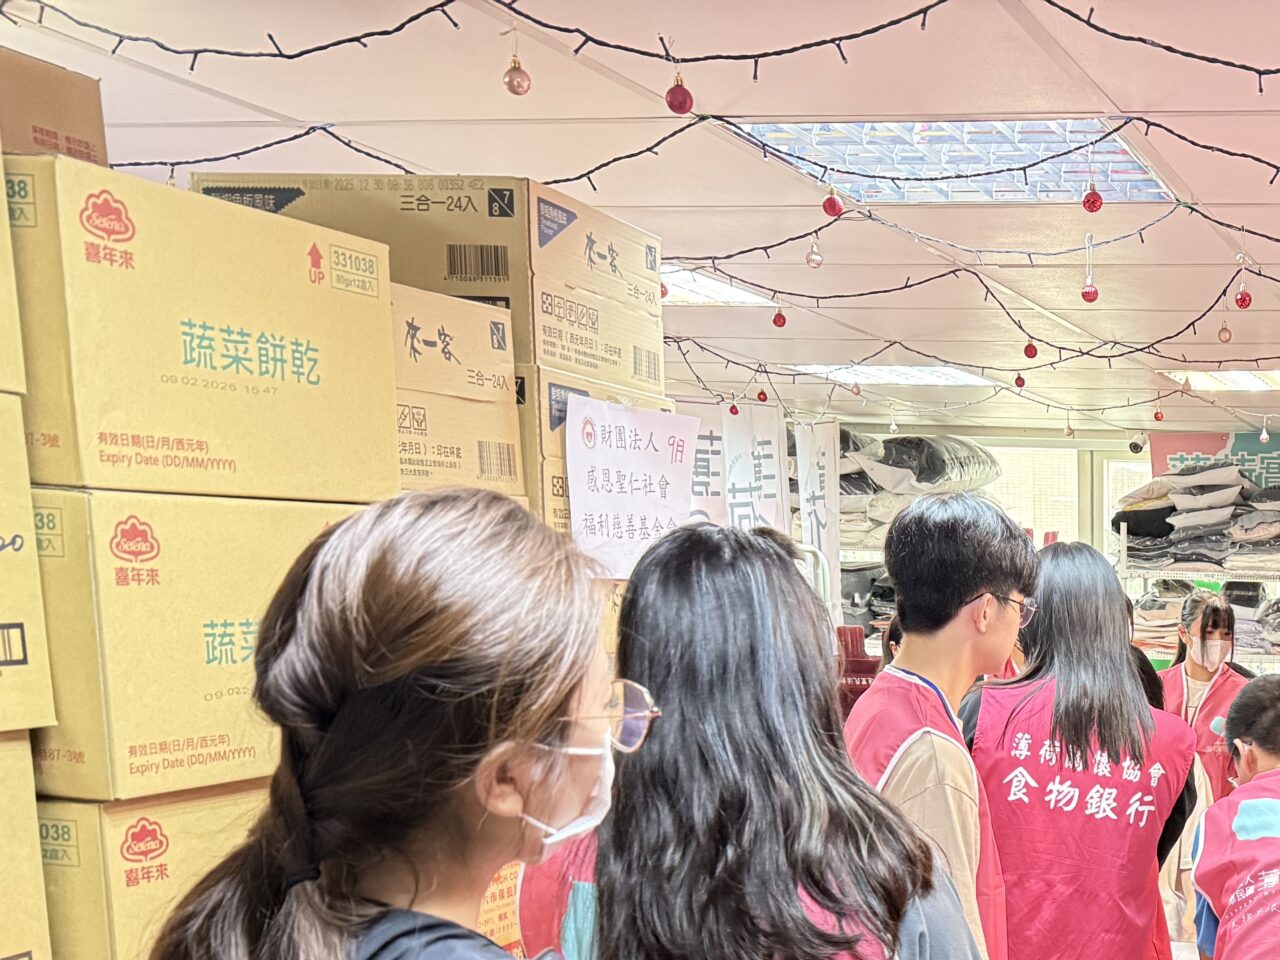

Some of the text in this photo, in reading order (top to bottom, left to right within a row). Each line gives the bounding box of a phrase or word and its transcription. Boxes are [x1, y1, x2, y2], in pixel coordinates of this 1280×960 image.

[400, 194, 479, 213] 三合一24入
[84, 240, 136, 271] 喜年來
[332, 249, 376, 276] 331038
[309, 269, 325, 285] UP
[179, 317, 321, 387] 蔬菜餅乾
[160, 373, 178, 385] 09
[181, 377, 199, 388] 02
[467, 368, 510, 392] 三合一24入
[600, 424, 660, 453] 財團法人
[99, 450, 133, 468] Expiry
[135, 452, 160, 467] Date
[114, 565, 161, 588] 喜年來
[128, 746, 257, 776] Expiry Date (DD/MM/YYYY)
[1003, 765, 1156, 829] 食物銀行
[124, 862, 171, 888] 喜年來
